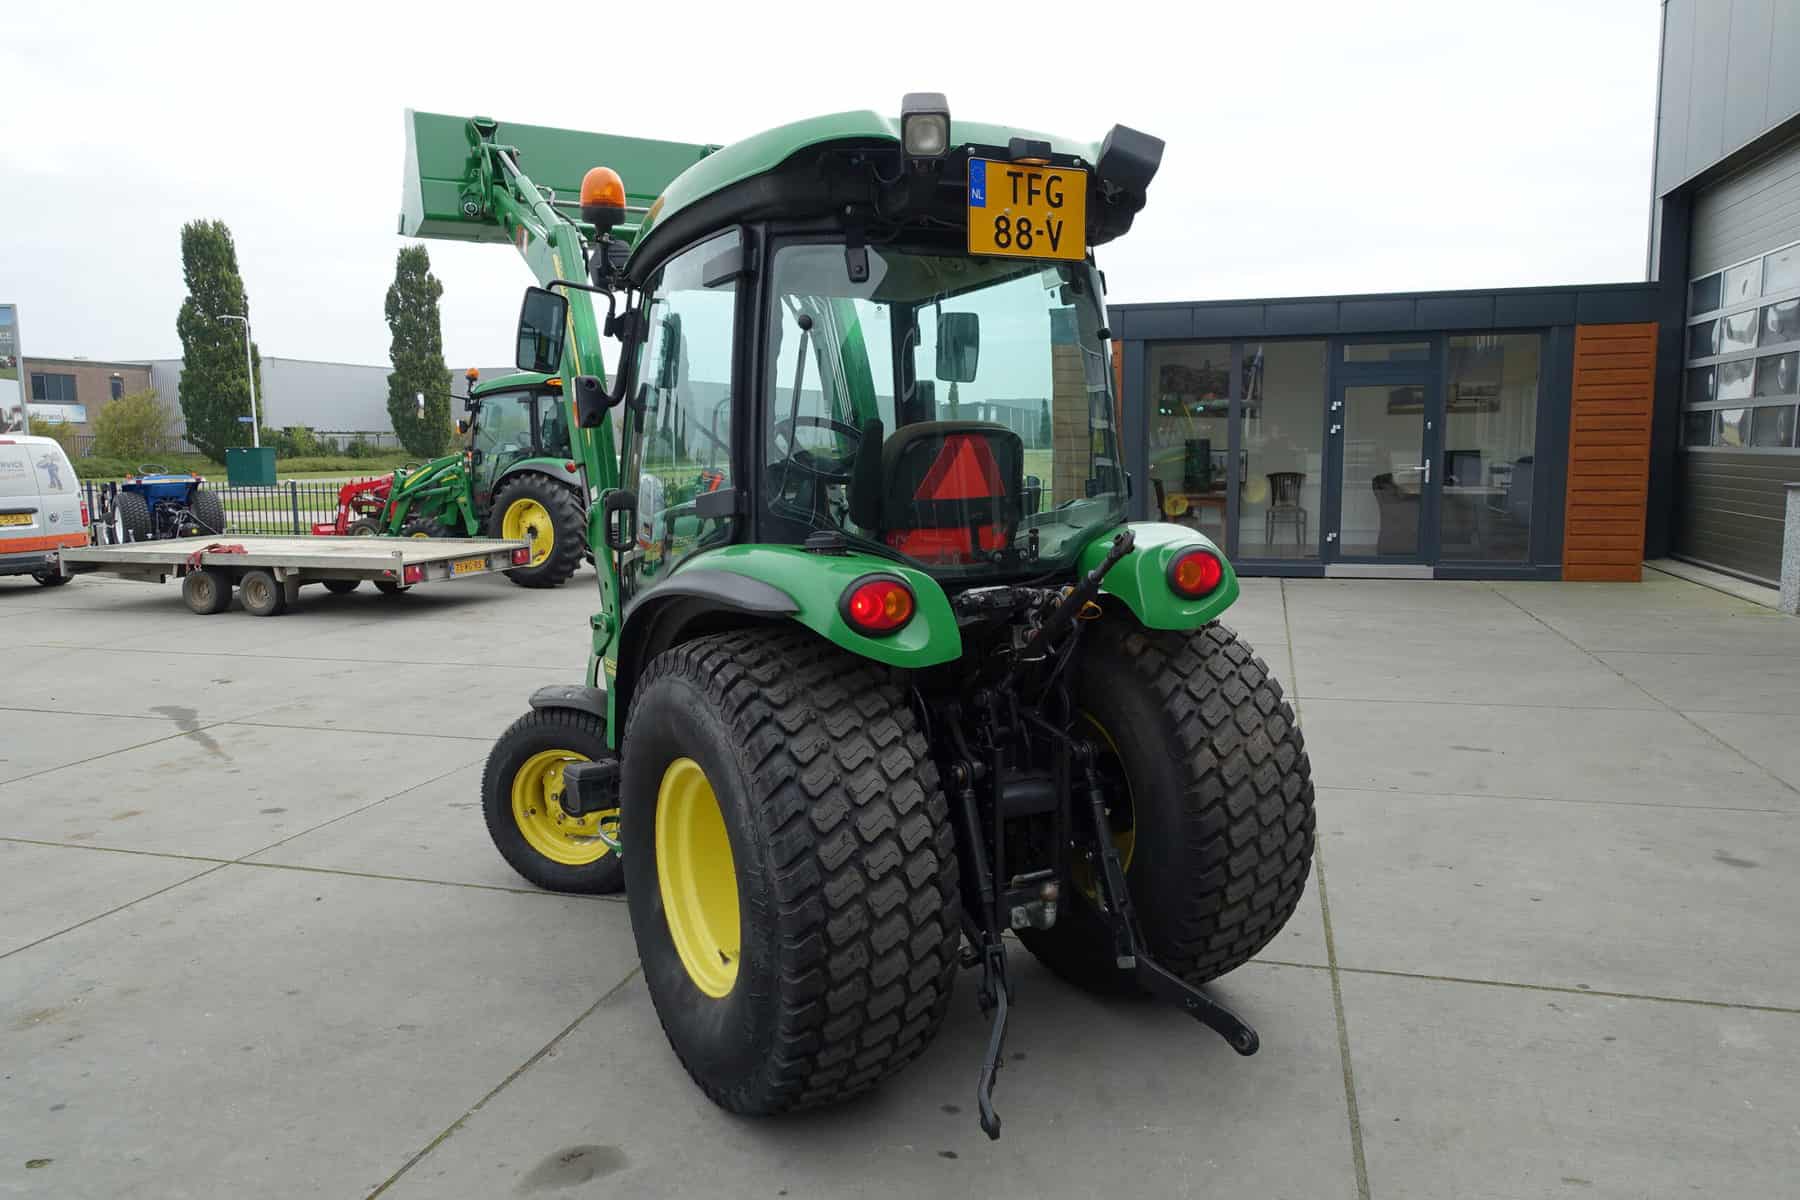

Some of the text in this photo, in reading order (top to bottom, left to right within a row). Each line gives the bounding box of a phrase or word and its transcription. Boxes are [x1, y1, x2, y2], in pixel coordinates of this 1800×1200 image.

[971, 188, 984, 200] NL
[1006, 170, 1064, 208] TFG
[993, 215, 1064, 253] 88-V
